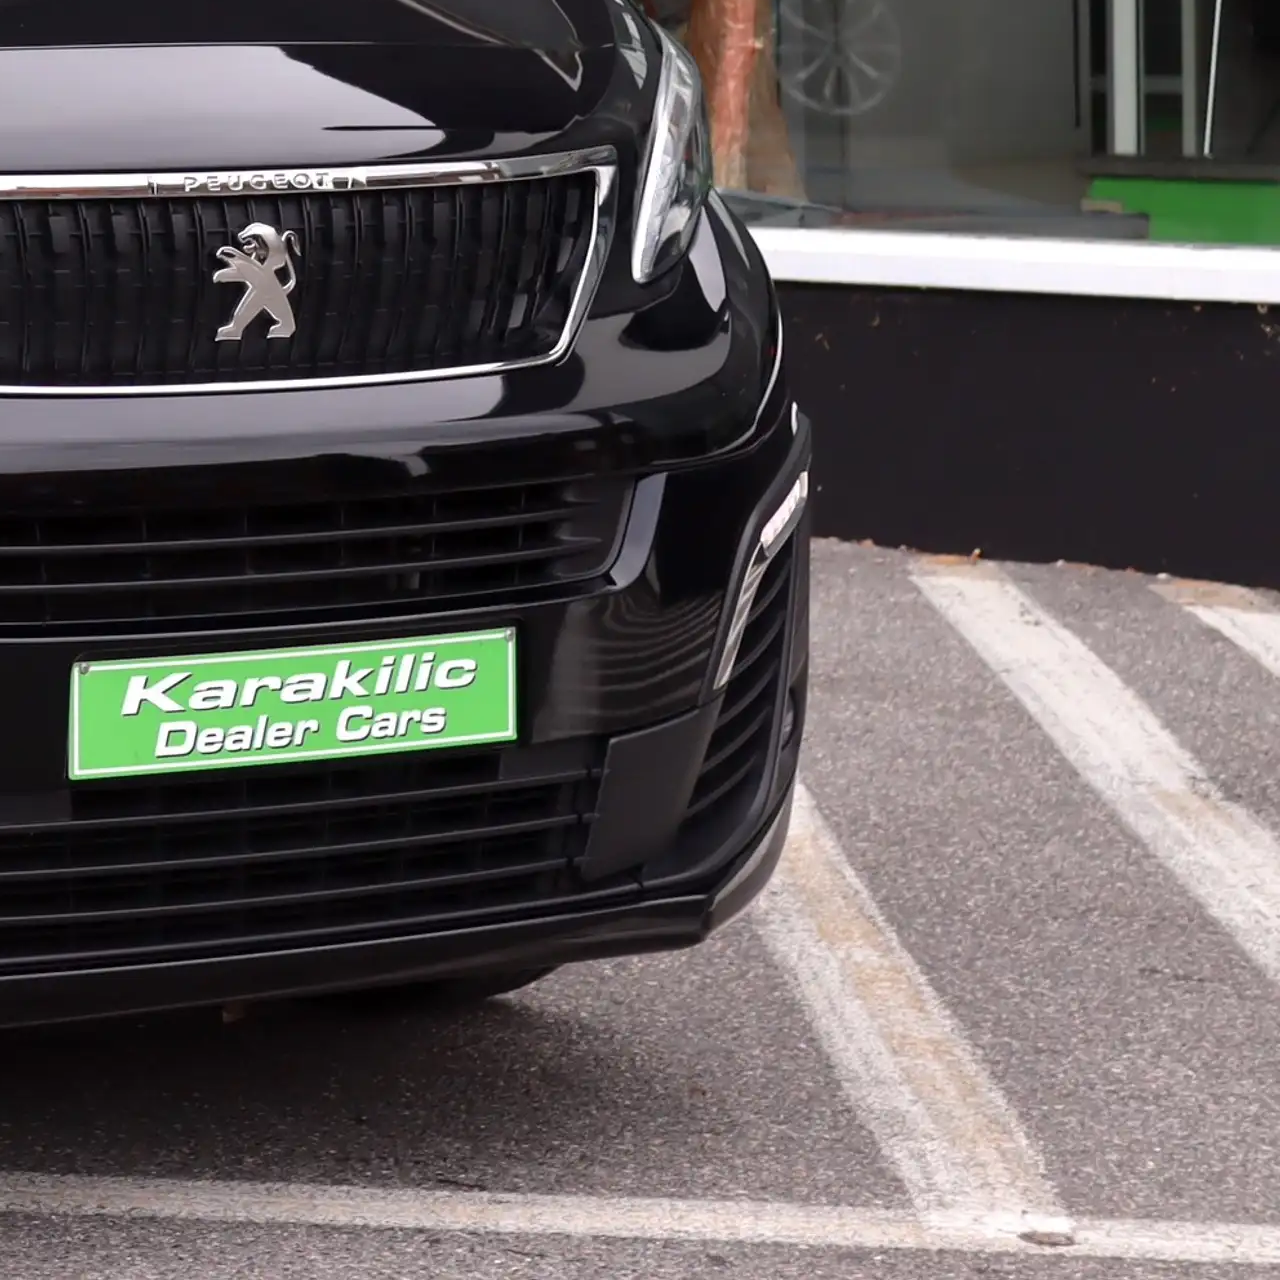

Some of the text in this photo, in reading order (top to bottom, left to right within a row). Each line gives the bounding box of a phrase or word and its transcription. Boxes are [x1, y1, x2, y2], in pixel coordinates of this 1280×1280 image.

[182, 171, 331, 193] PEUGEOT
[120, 651, 479, 717] Karakilic
[154, 704, 448, 759] Dealer Cars
